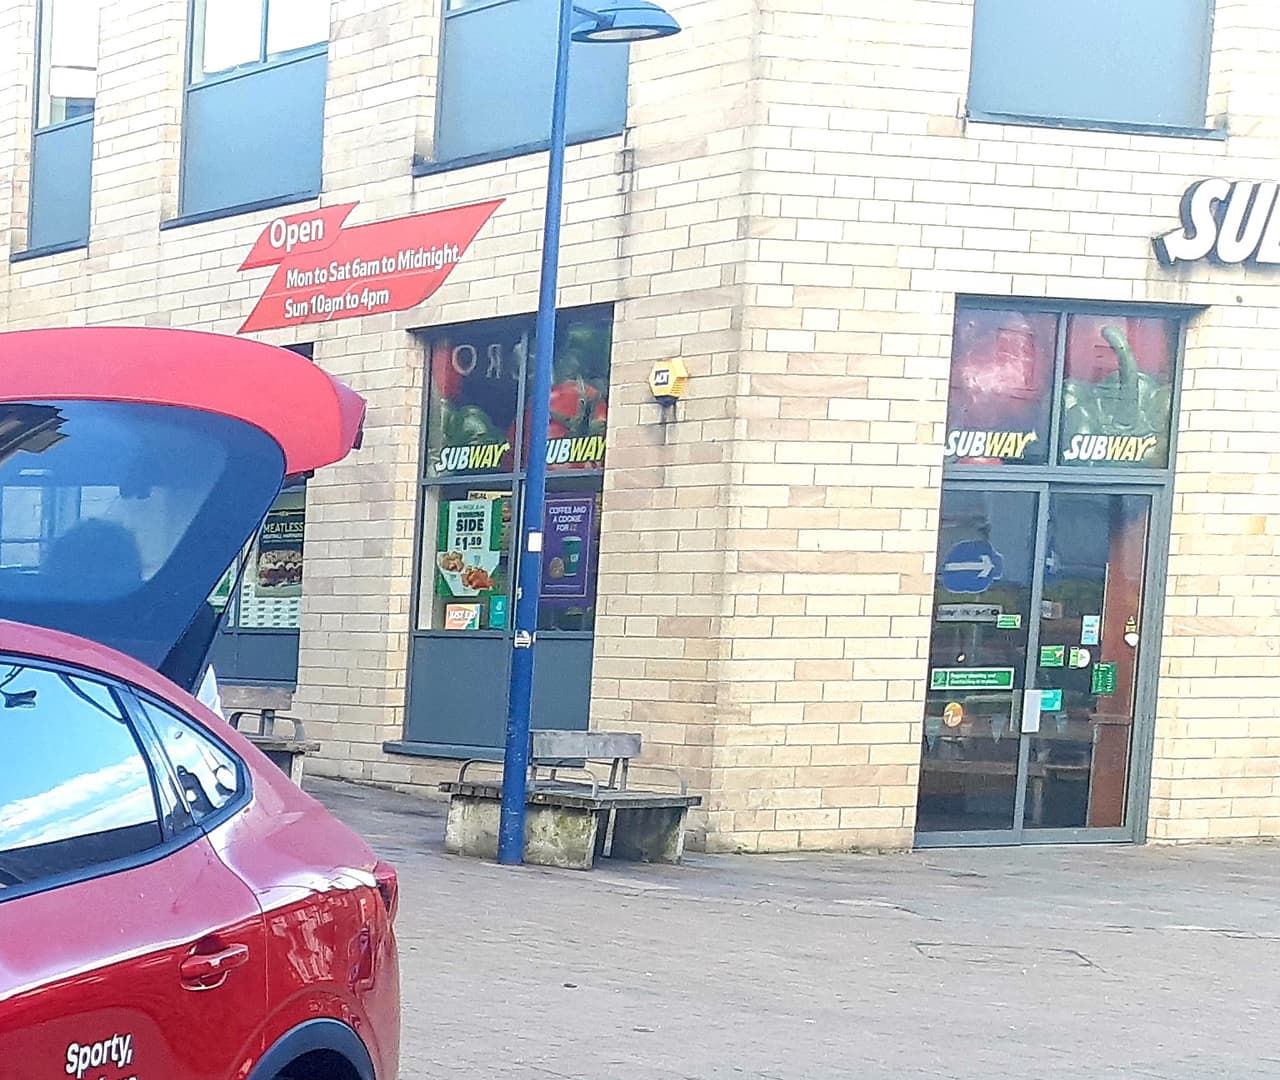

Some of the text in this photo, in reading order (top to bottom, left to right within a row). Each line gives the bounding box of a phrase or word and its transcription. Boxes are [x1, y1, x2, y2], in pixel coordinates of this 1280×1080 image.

[269, 218, 324, 252] Open
[286, 268, 313, 289] Mon
[314, 267, 327, 284] to
[329, 262, 351, 281] Sat
[352, 261, 380, 279] 6am
[381, 257, 395, 273] to
[285, 288, 389, 319] Sun 10am to 4pm
[435, 436, 607, 472] SUBWAY UBWAY
[944, 429, 1158, 462] SUBWAY SUBWAY
[263, 522, 303, 534] MEATLESS
[456, 519, 484, 532] SIDE
[65, 1034, 132, 1079] Sporty,
